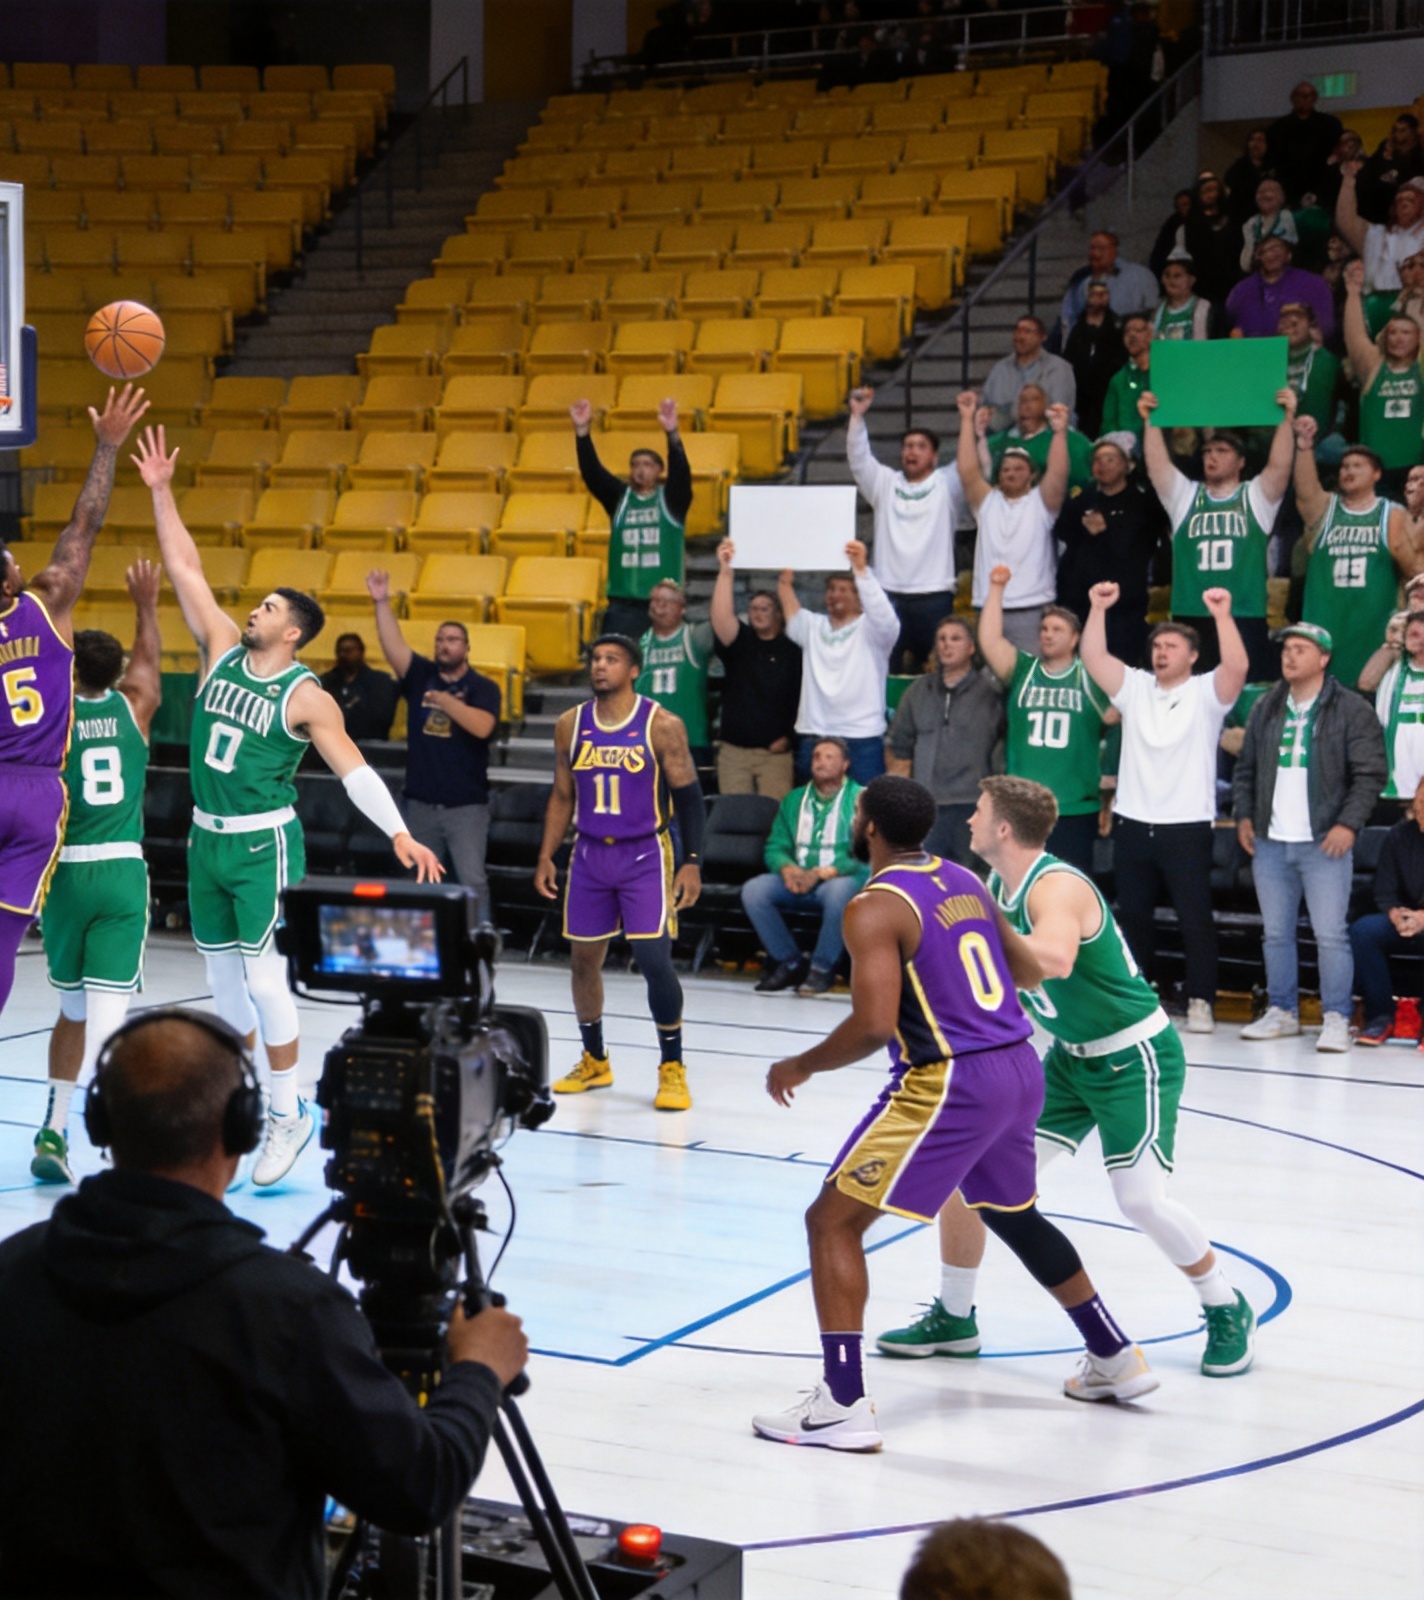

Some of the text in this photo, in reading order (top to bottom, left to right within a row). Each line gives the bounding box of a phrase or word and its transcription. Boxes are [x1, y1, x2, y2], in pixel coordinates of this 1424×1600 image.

[1197, 540, 1233, 571] 10
[2, 666, 45, 727] 5
[204, 721, 244, 774] 0
[1027, 711, 1070, 749] 10
[80, 745, 125, 806] 8
[592, 773, 621, 815] 11
[958, 931, 1005, 1012] 0
